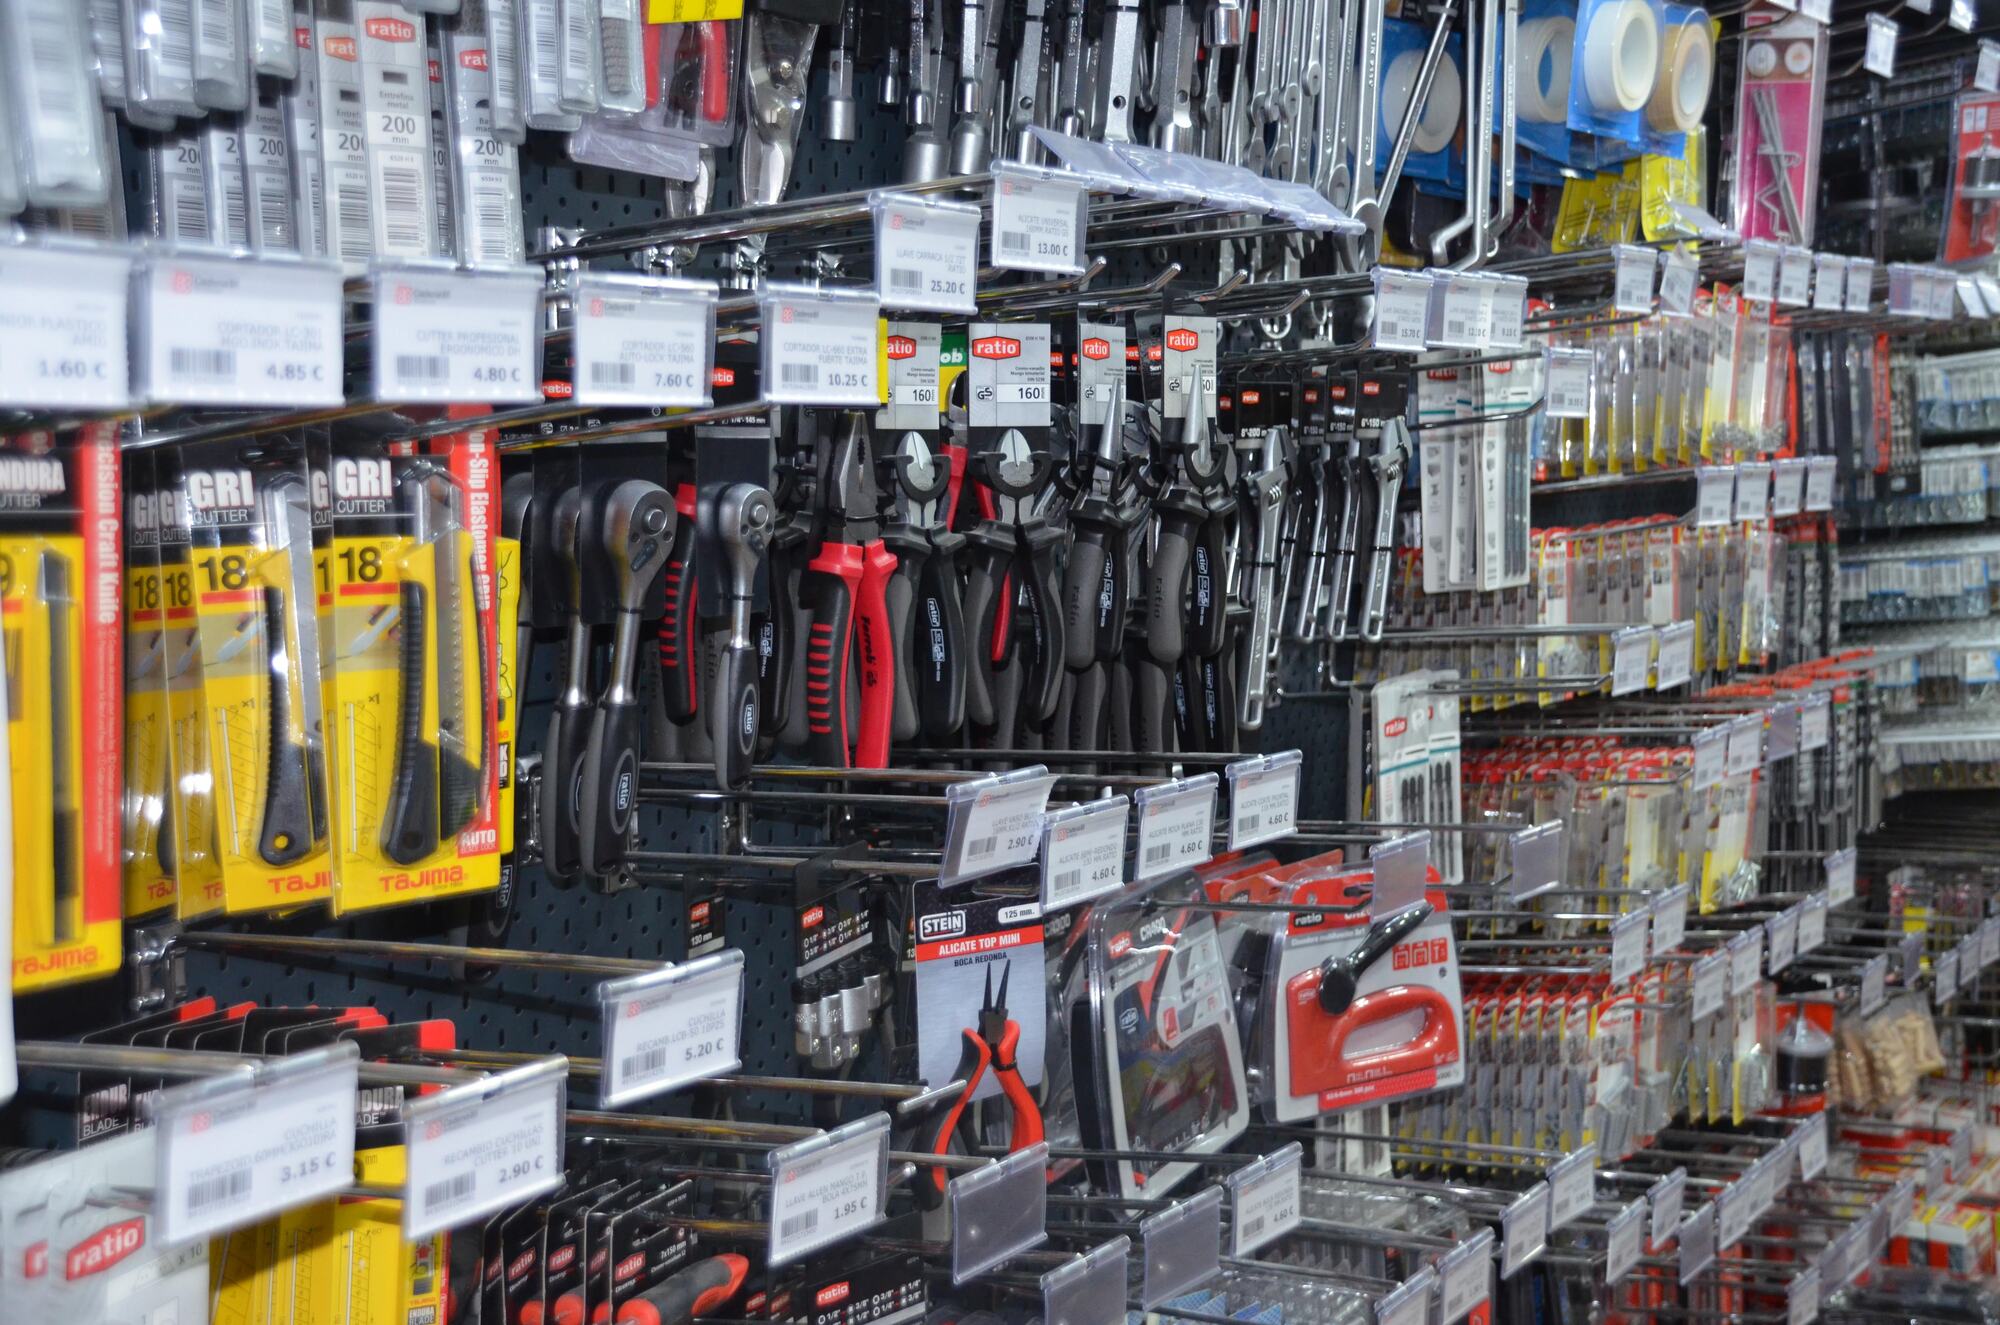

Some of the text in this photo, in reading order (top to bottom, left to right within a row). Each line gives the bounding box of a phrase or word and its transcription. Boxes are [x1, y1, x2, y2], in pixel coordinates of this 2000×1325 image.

[370, 22, 412, 40] ratio
[331, 40, 355, 54] rat
[464, 53, 488, 66] rat
[382, 115, 416, 135] 200
[259, 138, 284, 157] 200
[391, 136, 410, 145] mm
[475, 139, 504, 157] 200
[1037, 242, 1061, 256] 13.00
[930, 279, 957, 294] 25.20
[977, 343, 1017, 354] ratio
[1084, 343, 1109, 355] ratio
[1169, 334, 1196, 347] ratio
[38, 357, 87, 379] 1.60
[266, 363, 307, 381] 4.85
[473, 366, 507, 382] 4.80
[542, 383, 573, 394] ratio
[655, 373, 682, 388] 7.60
[828, 373, 858, 387] 10.25
[912, 389, 931, 402] 160
[1018, 387, 1040, 400] 160
[0, 456, 66, 492] NDURA
[97, 423, 119, 513] Precision
[336, 459, 393, 498] GRI
[190, 470, 254, 510] GRI
[0, 493, 42, 509] UTTER
[337, 499, 386, 514] CUTTER
[193, 509, 249, 525] CUTTER
[314, 510, 332, 525] CUT
[97, 519, 119, 569] Craft
[338, 545, 382, 583] 18
[1197, 547, 1208, 574] ratio
[199, 555, 249, 592] 18
[317, 556, 330, 594] 1
[134, 575, 159, 610] 18
[165, 571, 192, 607] 18
[97, 573, 119, 624] Knife
[928, 599, 940, 627] ratio
[745, 705, 754, 734] ratio
[617, 773, 630, 809] ratio
[1268, 812, 1283, 826] 4.60
[461, 829, 496, 847] AUTO
[1007, 836, 1027, 850] 2.90
[1179, 841, 1197, 855] 4.60
[1091, 867, 1110, 881] 4.60
[803, 910, 823, 924] ratio
[1004, 909, 1018, 919] 125
[1295, 912, 1323, 926] ratio
[938, 933, 1021, 956] ALICATE TOP MINI
[954, 952, 1008, 967] BOCA REDONDA
[684, 1041, 713, 1062] 5.20
[360, 1085, 404, 1112] DURA
[83, 1117, 120, 1137] BLADE
[357, 1112, 380, 1125] ADE
[280, 1156, 320, 1184] 3.15
[498, 1160, 531, 1184] 2.90
[834, 1199, 858, 1220] 1.95
[72, 1227, 138, 1273] ratio
[551, 1249, 574, 1267] ratio
[510, 1254, 534, 1276] ratio
[618, 1258, 644, 1276] ratio
[818, 1284, 849, 1302] ratio
